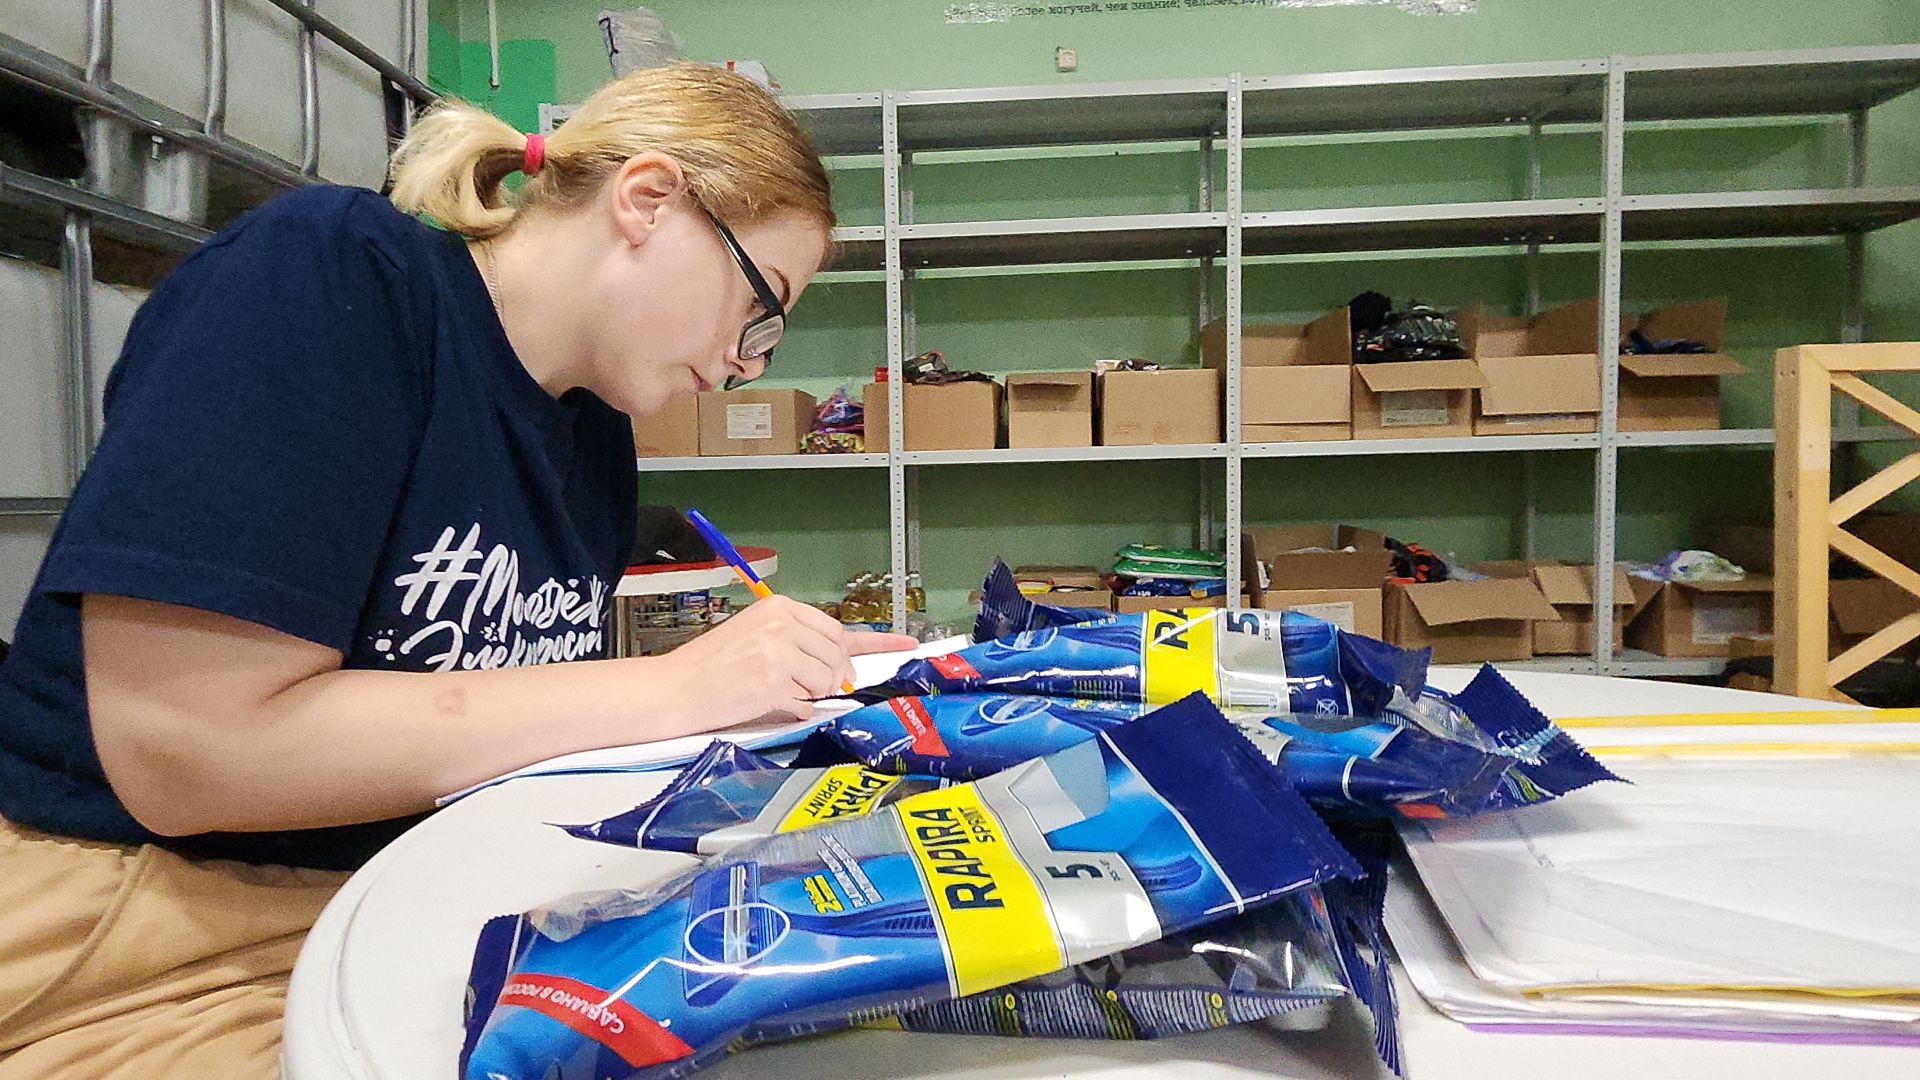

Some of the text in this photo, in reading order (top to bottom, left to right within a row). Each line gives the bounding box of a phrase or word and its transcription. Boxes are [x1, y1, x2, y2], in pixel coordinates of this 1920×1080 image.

[1105, 2, 1129, 11] чем
[1226, 611, 1260, 636] 5
[804, 777, 843, 817] SPRINT
[909, 808, 1005, 910] RAPIRA
[1044, 863, 1103, 878] 5
